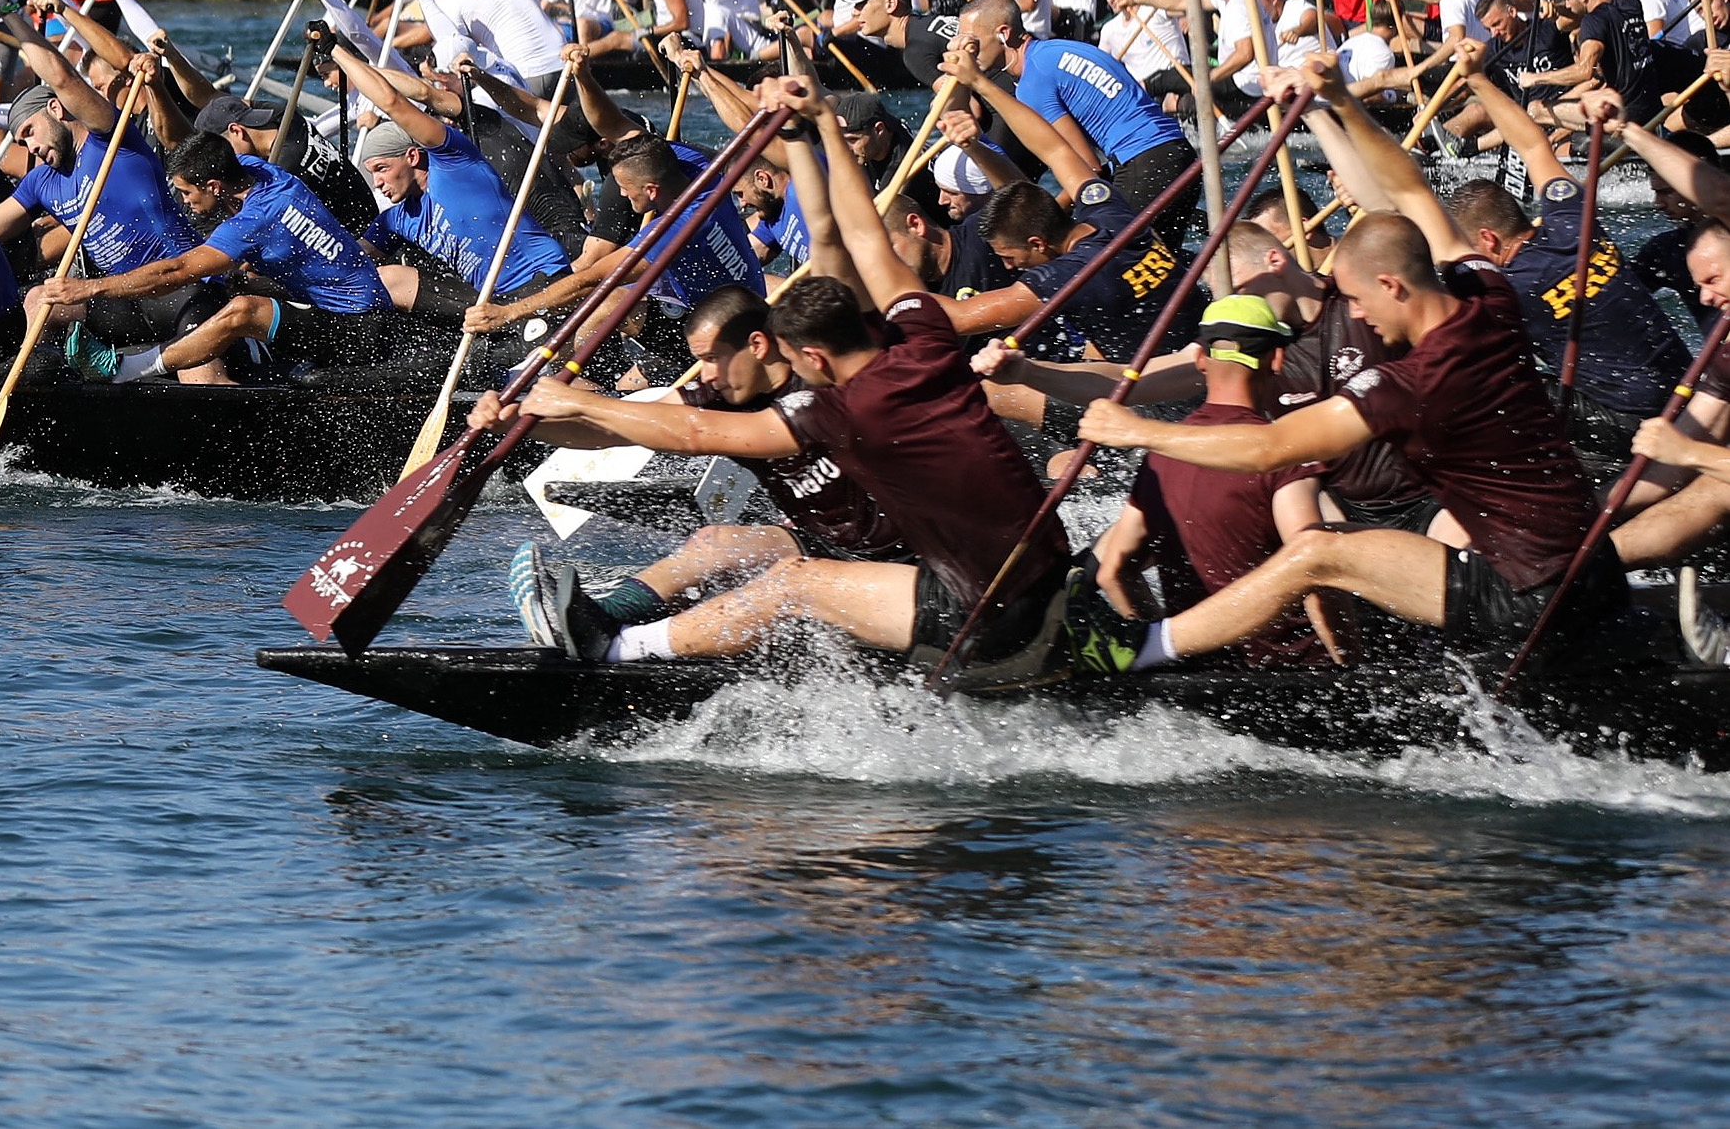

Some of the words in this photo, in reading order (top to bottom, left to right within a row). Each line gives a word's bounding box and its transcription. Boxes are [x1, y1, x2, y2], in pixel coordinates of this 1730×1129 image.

[1057, 51, 1123, 99] STABLINA
[280, 204, 344, 261] STABLINA
[705, 221, 749, 281] STABLINA
